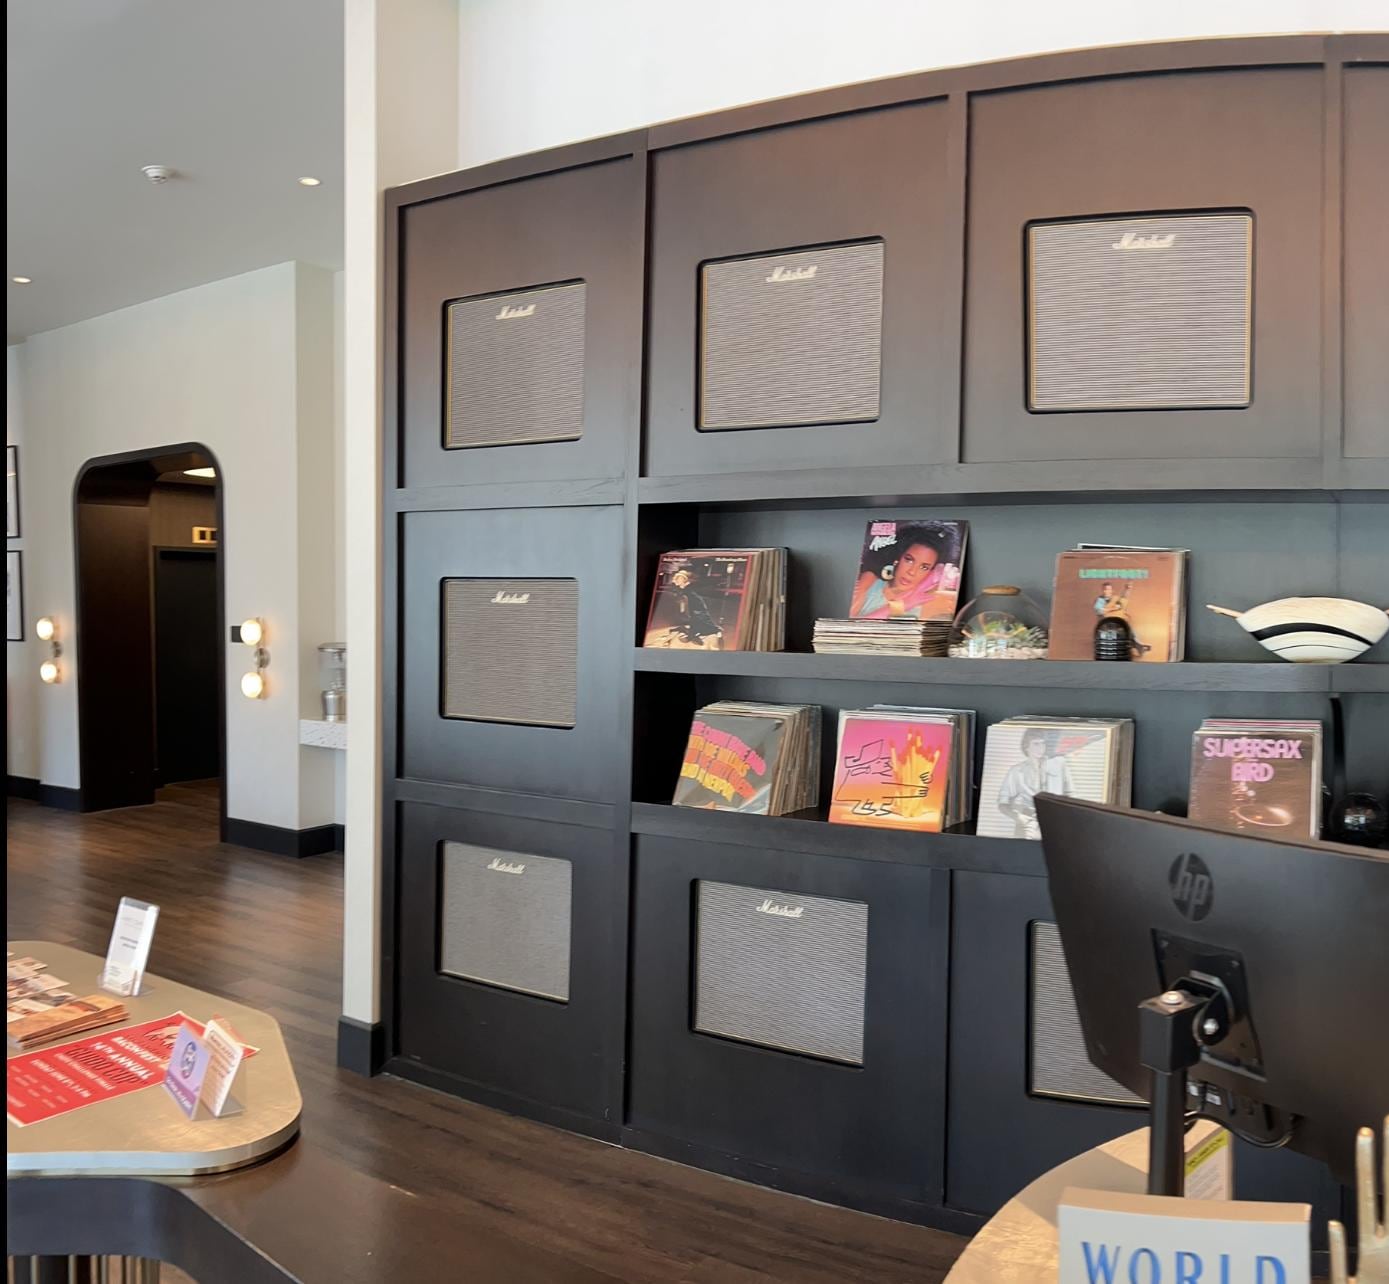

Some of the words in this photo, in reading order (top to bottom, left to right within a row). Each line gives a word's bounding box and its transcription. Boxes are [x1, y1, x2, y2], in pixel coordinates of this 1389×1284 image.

[1112, 232, 1177, 249] Marshall
[765, 266, 818, 283] Marshall
[491, 590, 531, 604] Marshall
[1203, 737, 1303, 759] SUPERSAX
[1231, 762, 1274, 782] BIRD
[487, 857, 526, 875] Marshall
[1171, 852, 1212, 921] hp
[756, 899, 804, 919] Marshall
[105, 1052, 158, 1080] ANNUAL
